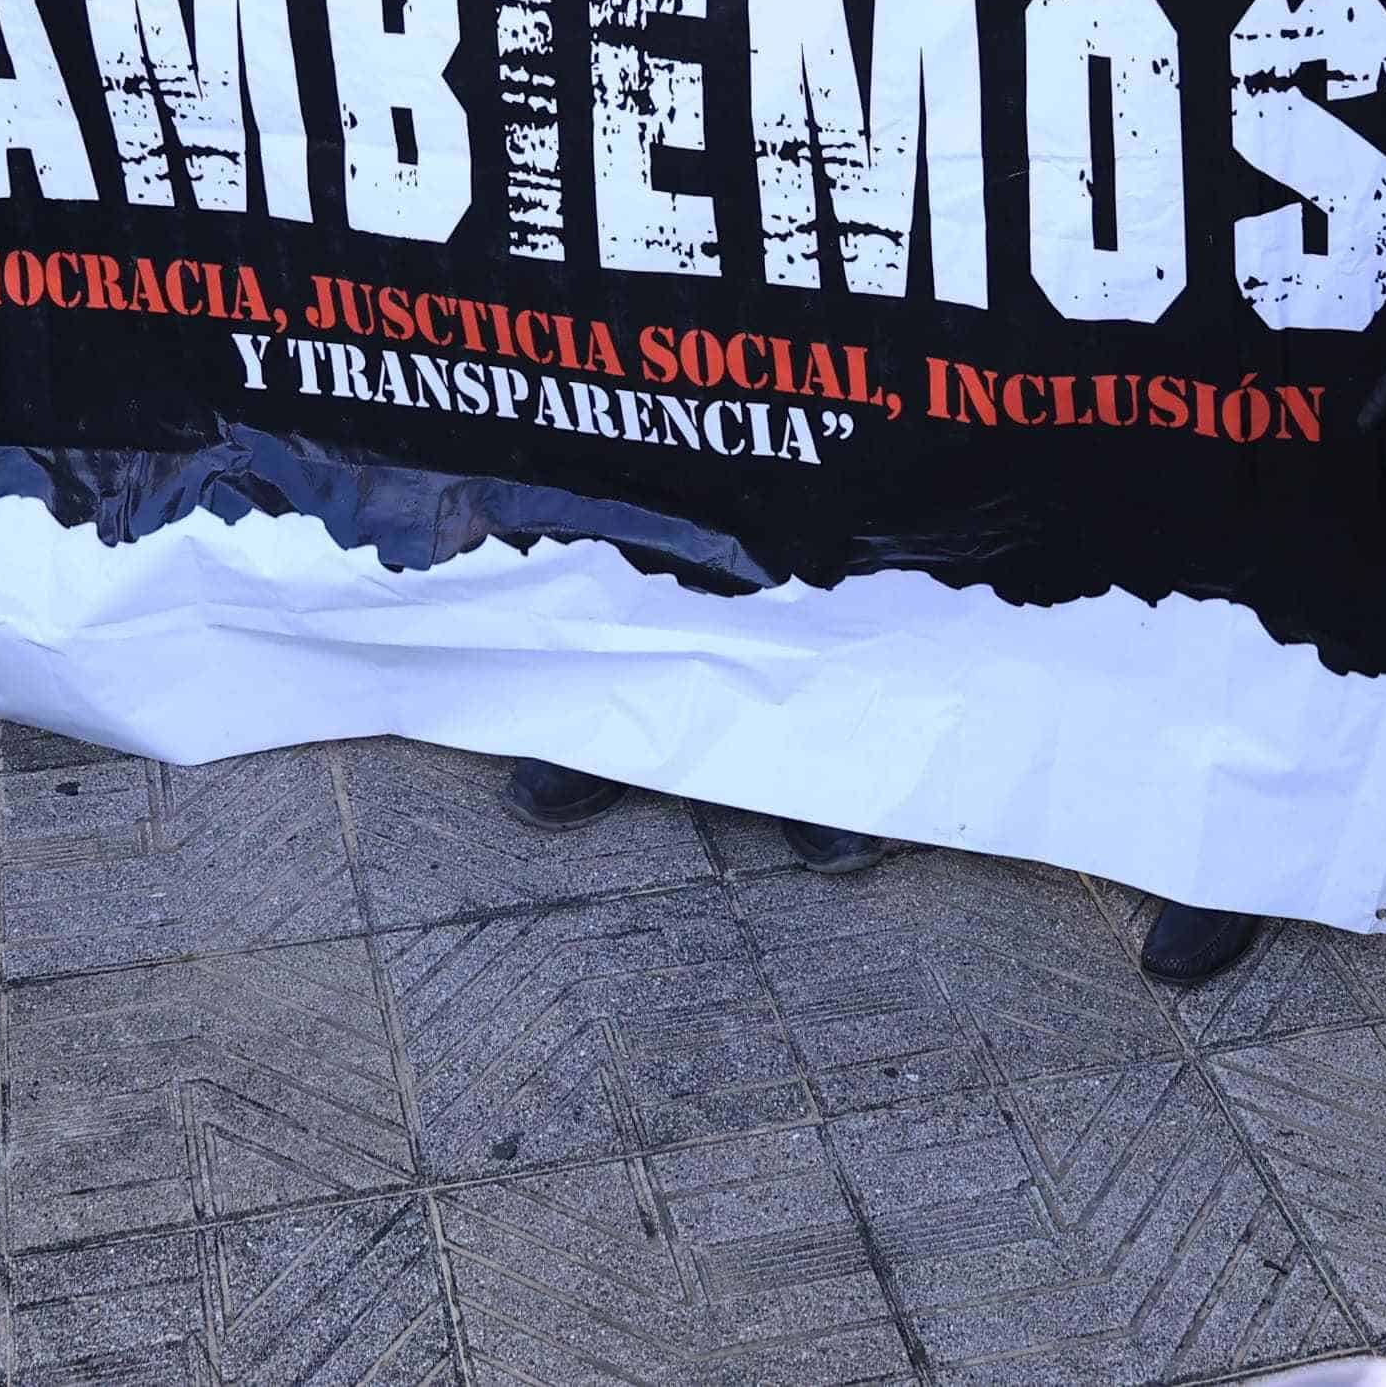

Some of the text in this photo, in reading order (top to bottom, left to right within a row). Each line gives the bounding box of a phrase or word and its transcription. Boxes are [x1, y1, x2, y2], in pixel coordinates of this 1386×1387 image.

[230, 333, 272, 390] Y
[304, 274, 625, 377] JUSCTICIA
[638, 324, 903, 421] SOCIAL,
[925, 356, 1326, 444] INCLUSIÓN
